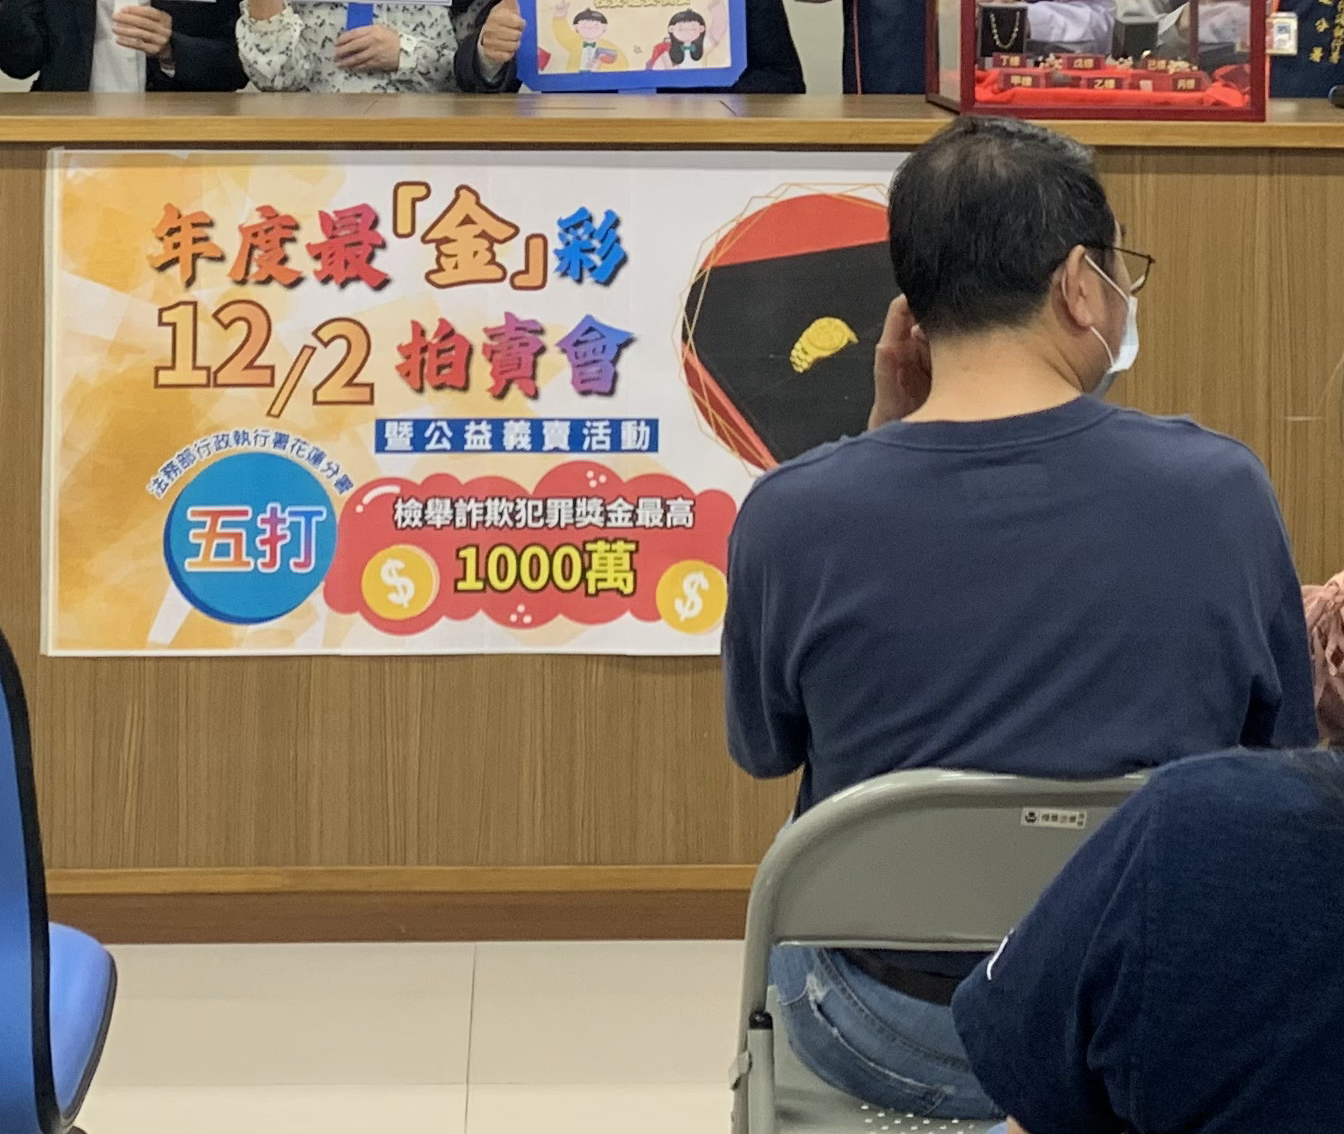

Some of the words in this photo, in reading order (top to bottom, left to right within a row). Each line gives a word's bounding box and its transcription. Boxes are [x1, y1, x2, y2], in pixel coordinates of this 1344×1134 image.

[153, 300, 375, 419] 12/2
[395, 312, 635, 399] 拍賣會
[147, 428, 354, 499] 法務部行政執行署花蓮分署
[383, 420, 652, 452] 暨公益義賣活動
[184, 502, 327, 574] 五打
[393, 496, 696, 530] 檢舉詐欺犯罪獎金最高
[455, 539, 637, 597] 1000萬
